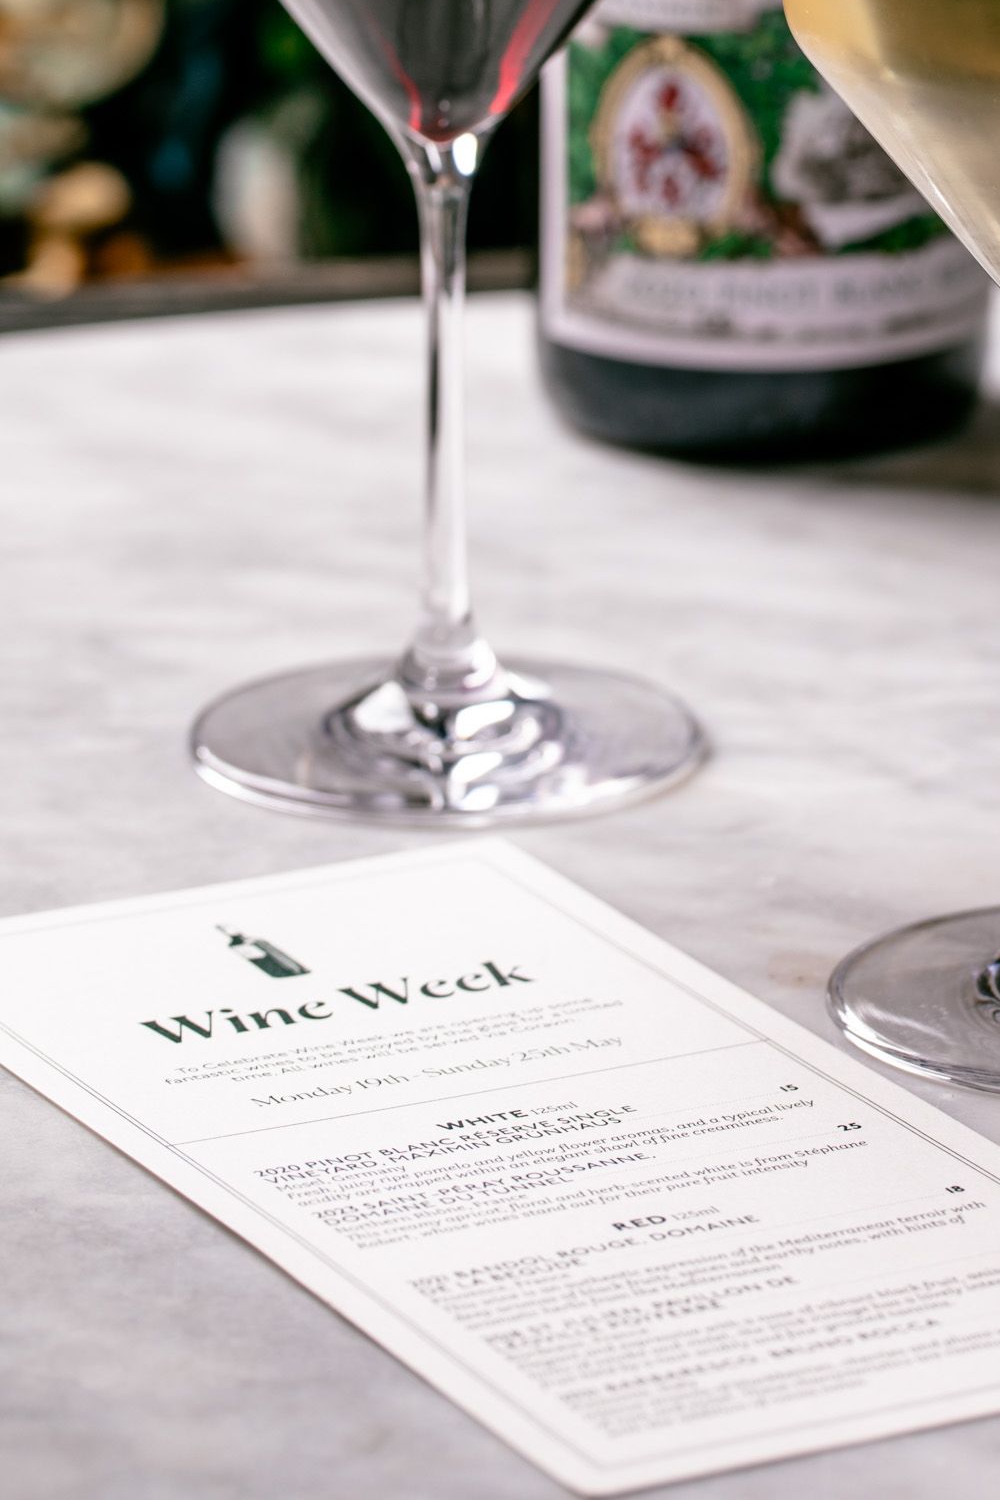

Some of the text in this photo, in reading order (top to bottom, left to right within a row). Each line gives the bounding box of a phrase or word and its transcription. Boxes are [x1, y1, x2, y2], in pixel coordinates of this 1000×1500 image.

[139, 960, 533, 1044] Wine Week
[164, 1069, 235, 1085] fantastic
[248, 1060, 295, 1072] wines
[319, 1051, 343, 1059] be
[347, 1037, 415, 1054] enjoyed
[202, 1052, 288, 1070] Celebrate
[295, 1044, 335, 1055] Wine
[342, 1035, 383, 1047] Week
[250, 1086, 352, 1107] Monday
[355, 1074, 410, 1089] 19th
[421, 1058, 511, 1078] Sunday
[511, 1045, 571, 1062] 25th
[569, 1037, 622, 1051] May
[281, 1065, 303, 1074] All
[312, 1057, 359, 1069] wines
[366, 1050, 391, 1060] will
[395, 1046, 419, 1054] be
[388, 1140, 491, 1164] MAXIMIN
[495, 1116, 622, 1144] GRÜNHAUS
[779, 1083, 799, 1093] 15
[435, 1101, 579, 1131] WHITE 125ml
[253, 1105, 638, 1178] 2020 PINOT BLANC RÉSERVE SINGLE
[297, 1116, 784, 1207] acidity are wrapped within an elegant shawl of fine creaminess.
[338, 1179, 375, 1193] juicy
[379, 1173, 409, 1184] ripe
[413, 1162, 471, 1179] pomelo
[474, 1155, 504, 1167] and
[506, 1147, 556, 1162] yellow
[558, 1138, 607, 1153] flower
[610, 1127, 675, 1142] aromas,
[676, 1118, 706, 1130] and
[721, 1106, 774, 1122] typical
[774, 1099, 814, 1112] lively
[323, 1122, 863, 1226] DOMAINE DU TUNNEL 25
[331, 1165, 406, 1182] Germany
[508, 1196, 553, 1213] floral
[555, 1190, 587, 1202] and
[692, 1164, 736, 1176] white
[754, 1154, 793, 1167] from
[794, 1140, 868, 1157] Stéphane
[522, 1203, 567, 1217] stand
[570, 1198, 595, 1208] out
[598, 1194, 621, 1205] for
[624, 1186, 661, 1198] their
[665, 1179, 700, 1192] pure
[702, 1171, 739, 1185] fruit
[741, 1159, 808, 1176] intensity
[944, 1185, 966, 1194] 18
[611, 1205, 721, 1232] RED 125ml
[649, 1215, 760, 1241] DOMAINE
[778, 1220, 896, 1248] Mediterranean
[896, 1209, 947, 1224] terroir
[950, 1201, 986, 1213] with
[868, 1227, 904, 1240] with
[903, 1220, 947, 1233] hints
[949, 1214, 966, 1225] of
